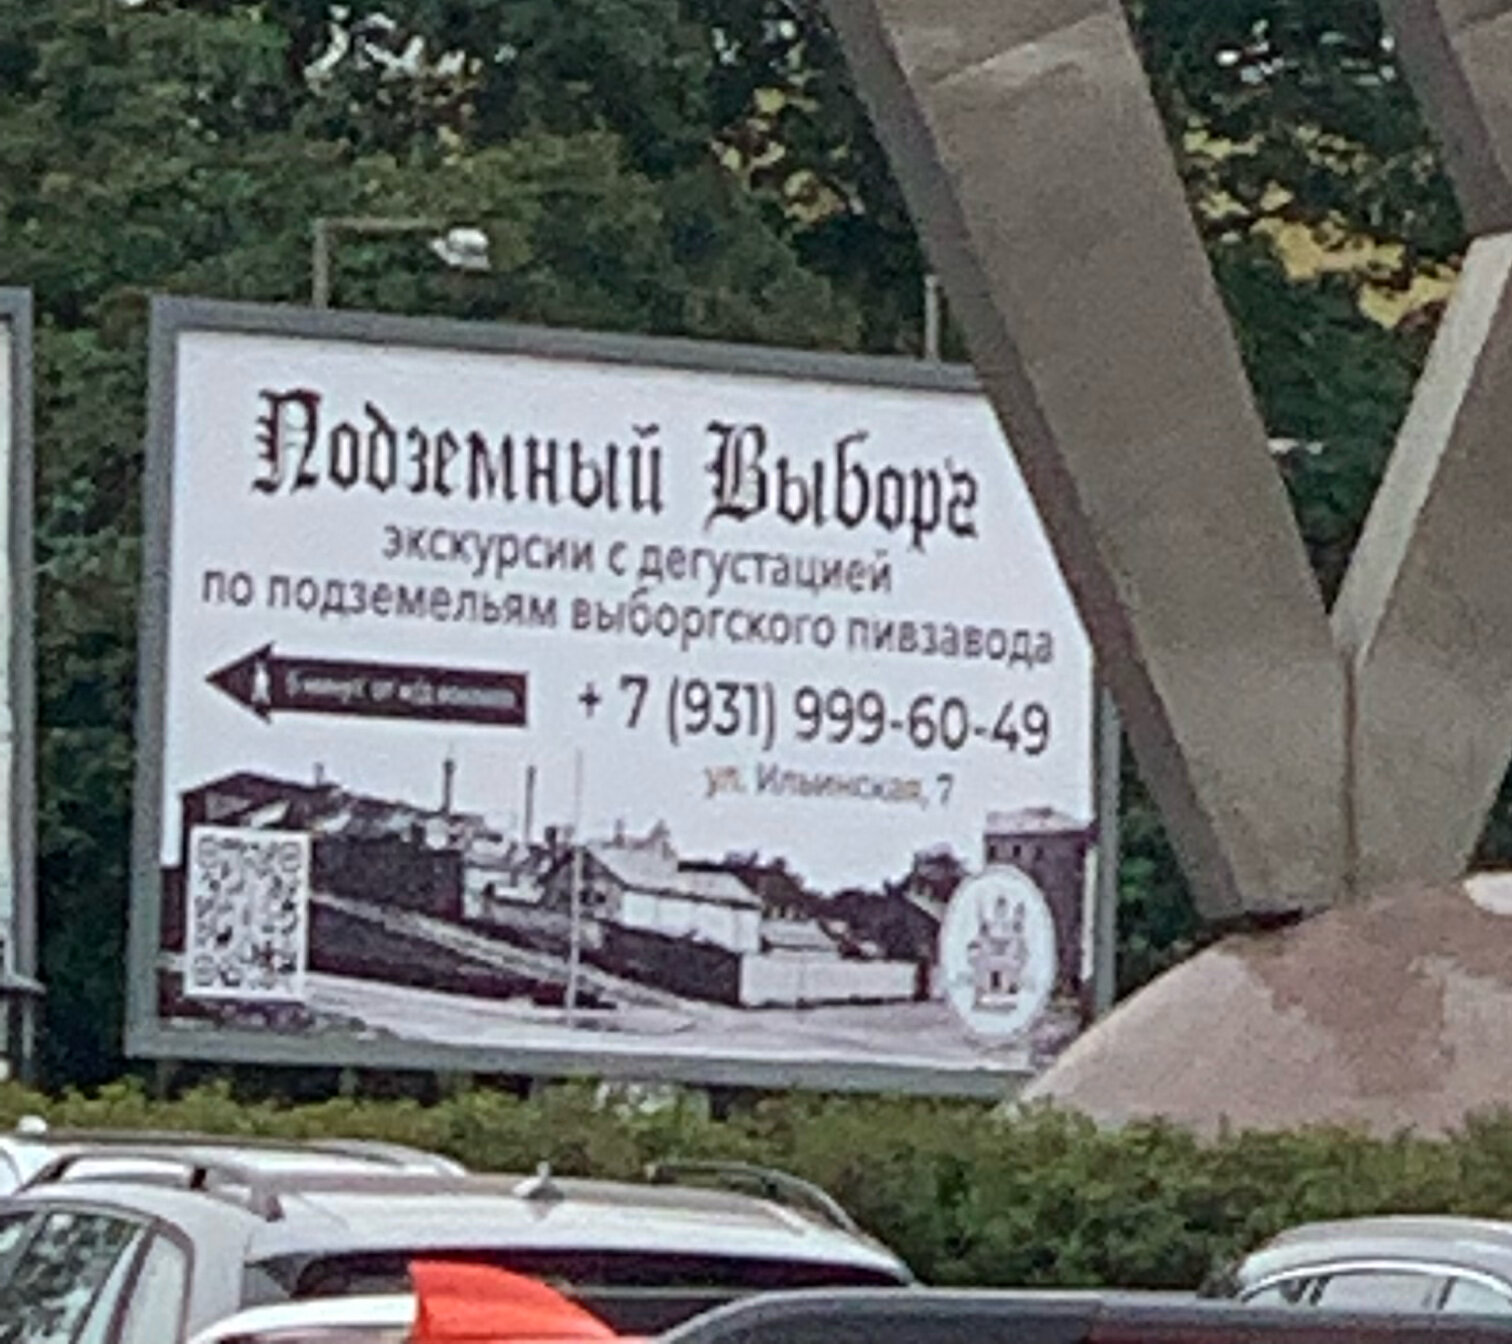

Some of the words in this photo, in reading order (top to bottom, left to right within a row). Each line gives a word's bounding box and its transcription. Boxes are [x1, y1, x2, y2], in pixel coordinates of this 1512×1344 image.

[252, 387, 664, 514] Подземный
[704, 419, 979, 554] Выборг
[382, 523, 594, 579] экскурсии
[607, 539, 628, 574] с
[636, 542, 894, 598] дегустацией
[202, 569, 255, 608] по
[266, 574, 558, 629] подземельям
[571, 588, 836, 651] выборгского
[848, 617, 1055, 670] пивзавода
[667, 674, 775, 750] (931)
[794, 685, 1051, 756] 999-60-49
[936, 772, 955, 805] 7
